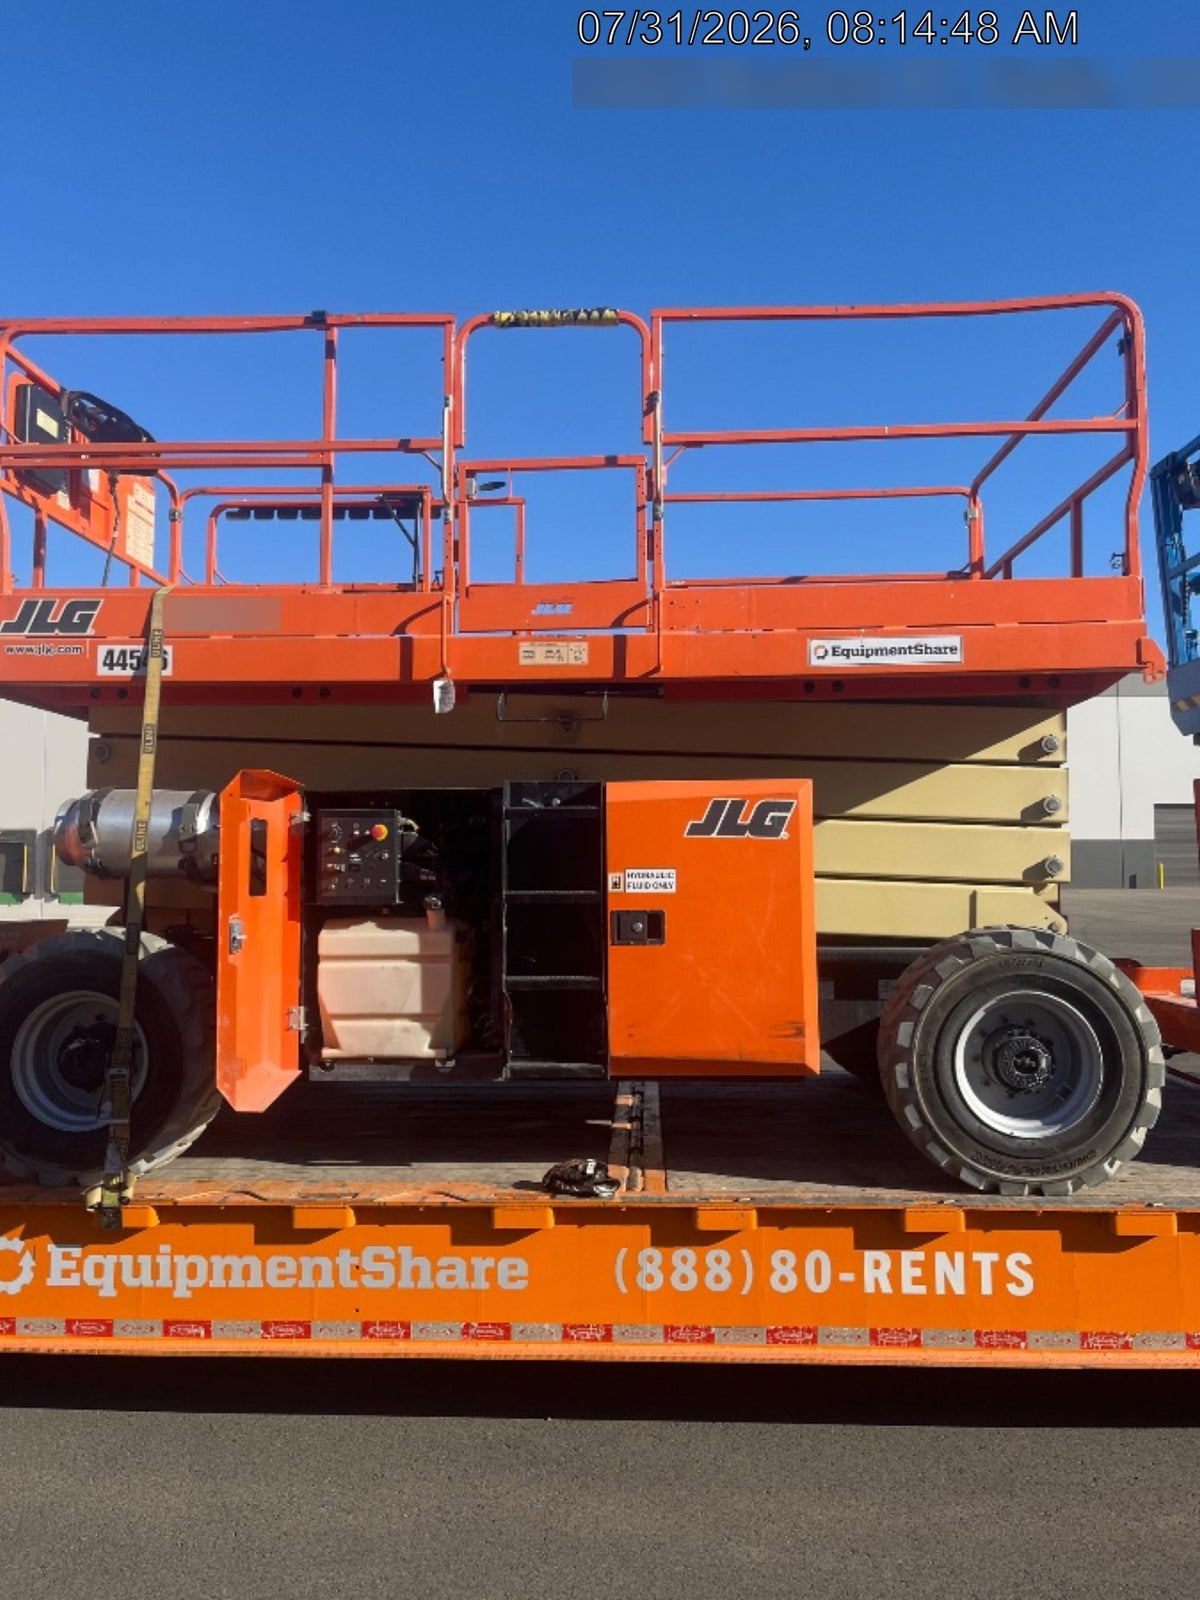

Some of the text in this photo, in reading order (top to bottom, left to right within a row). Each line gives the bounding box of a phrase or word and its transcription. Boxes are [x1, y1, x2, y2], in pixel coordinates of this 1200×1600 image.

[0, 599, 104, 635] JLG
[831, 644, 957, 660] EquipmentShare
[683, 798, 797, 839] JLG
[627, 881, 673, 890] FLUID ONLY
[46, 1244, 529, 1298] EquipmentShare
[614, 1247, 1034, 1296] (888) 80-RENTS
